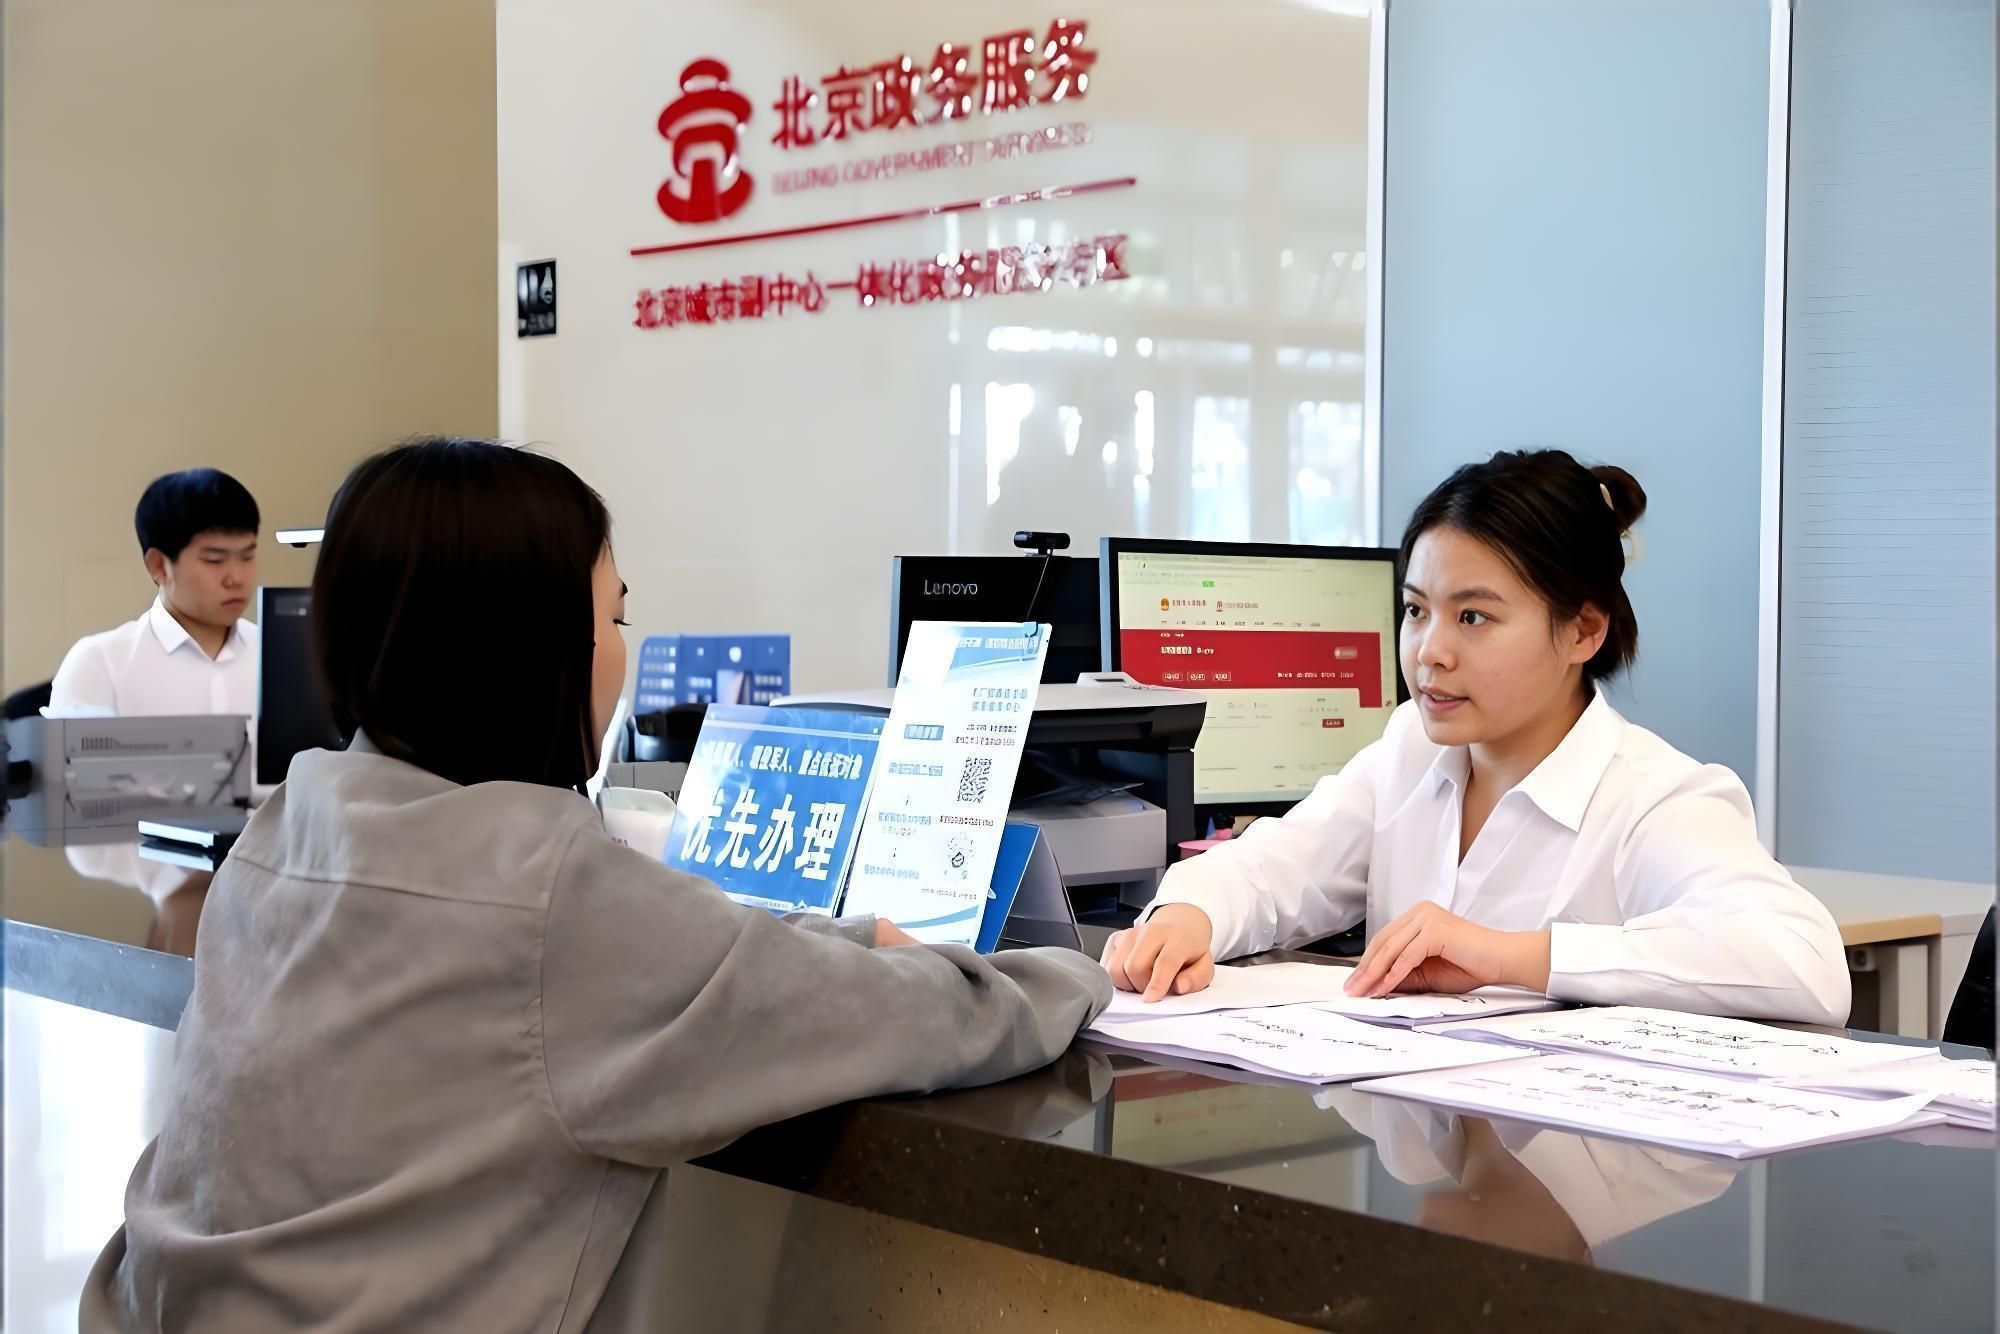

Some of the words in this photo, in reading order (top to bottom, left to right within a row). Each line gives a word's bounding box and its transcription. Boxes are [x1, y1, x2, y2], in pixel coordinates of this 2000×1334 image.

[771, 18, 1098, 150] 北京政务服务
